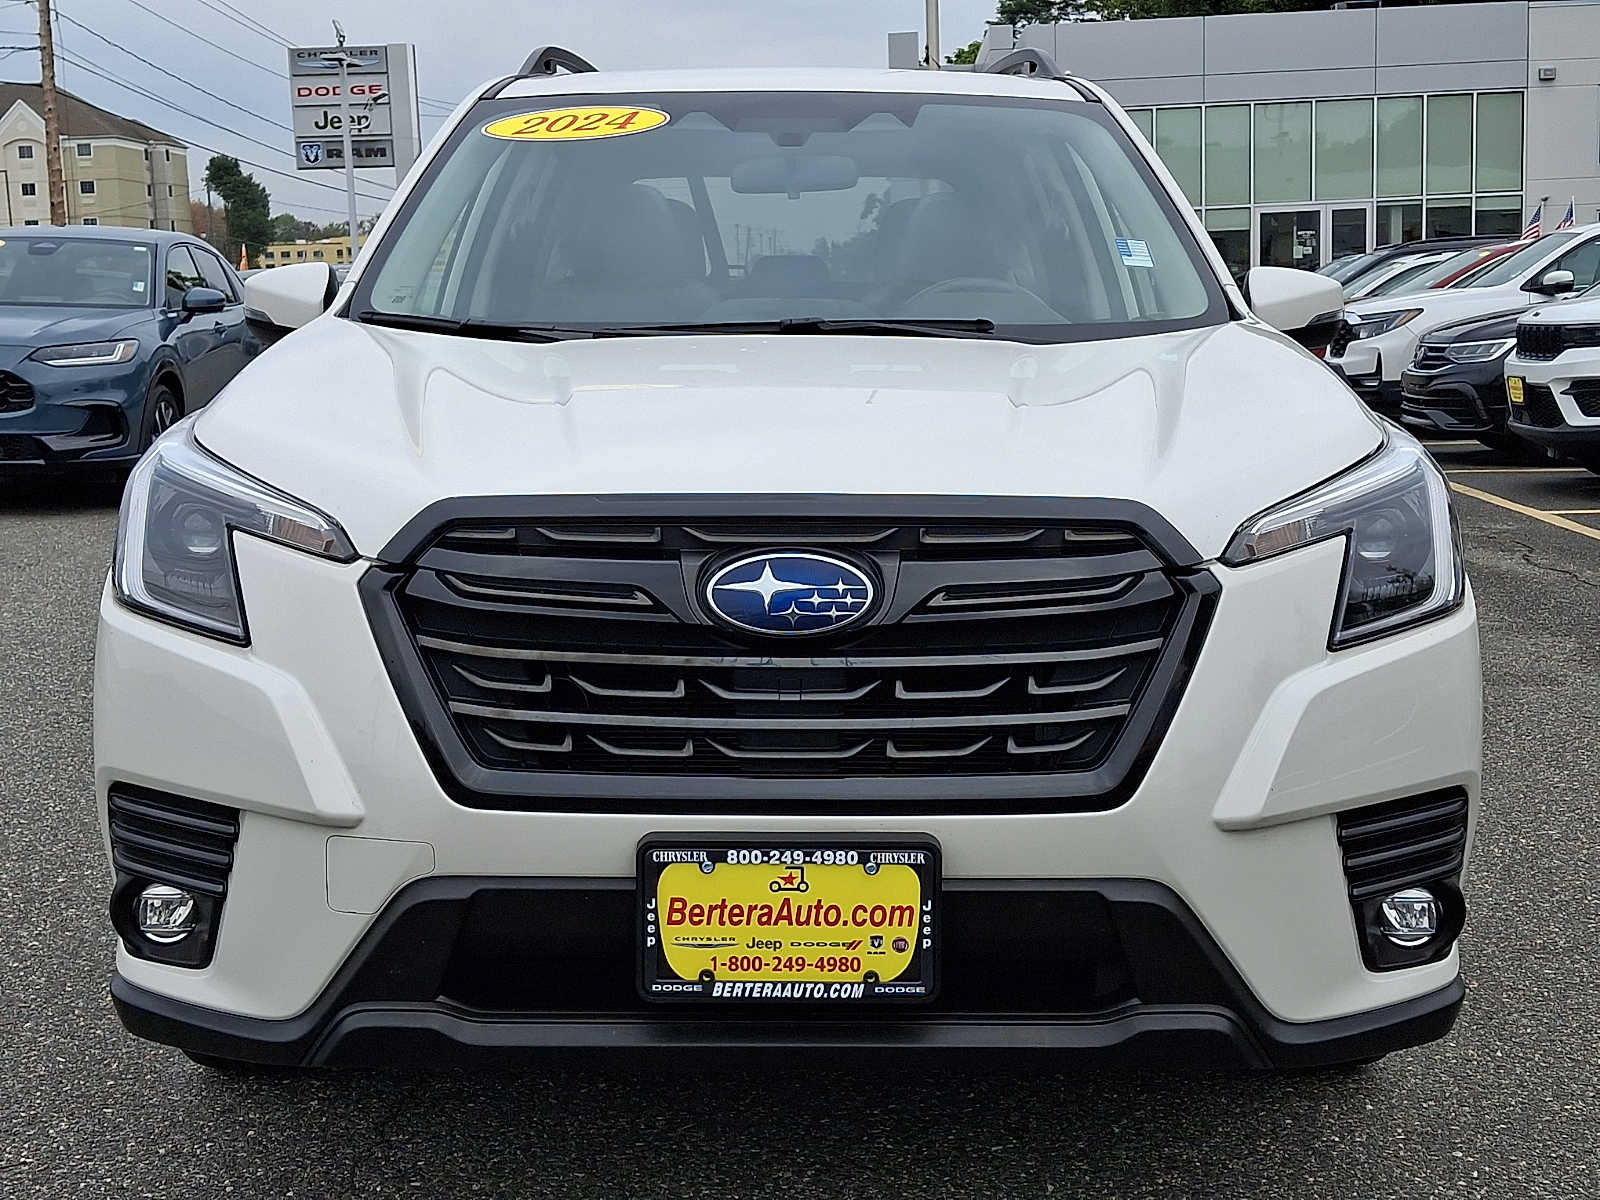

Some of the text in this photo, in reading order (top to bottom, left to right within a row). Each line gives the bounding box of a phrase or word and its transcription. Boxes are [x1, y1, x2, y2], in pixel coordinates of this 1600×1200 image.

[297, 49, 378, 59] CHLER
[511, 111, 639, 136] 2024
[652, 851, 708, 862] CHRYSLER
[727, 850, 858, 865] 800-249-4980
[870, 852, 925, 864] CHRYSLER
[666, 897, 915, 927] BerteraAuto.com
[646, 898, 656, 948] Jeep
[922, 900, 932, 950] Jeep
[746, 937, 782, 951] Jeep
[710, 955, 862, 973] 1-800-249-4980
[712, 982, 865, 998] BERTERAAUTO.COM
